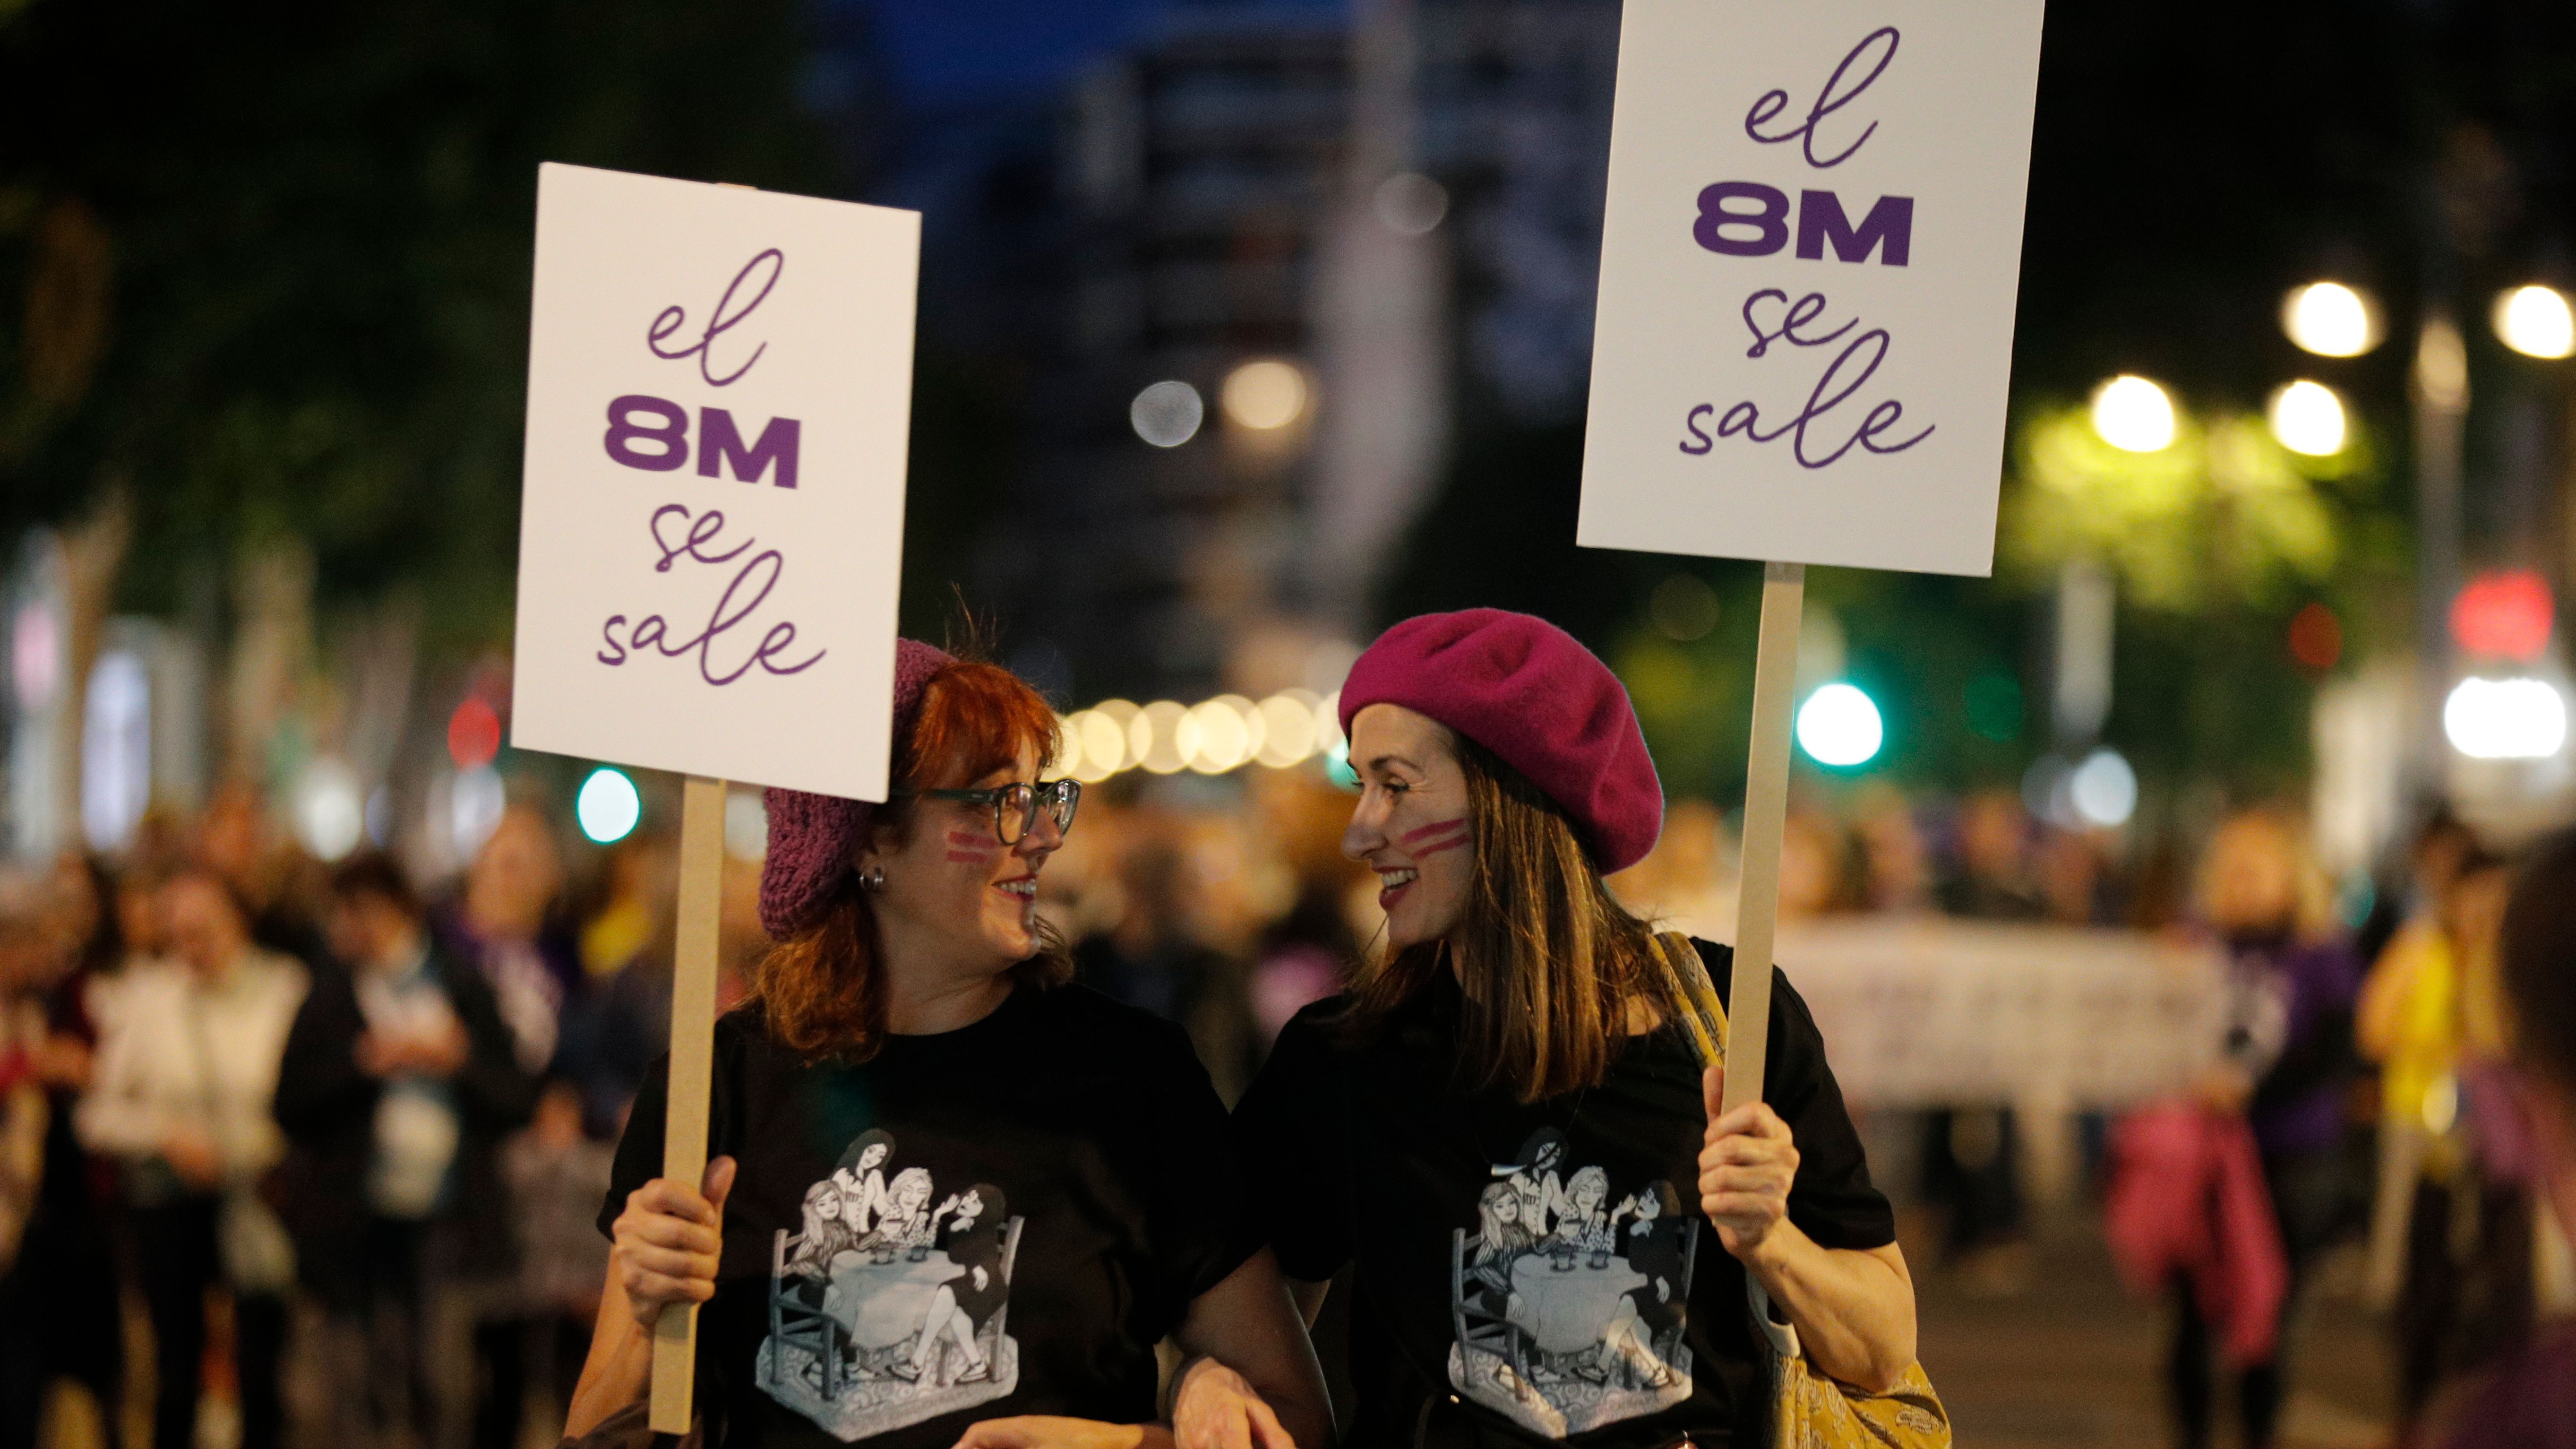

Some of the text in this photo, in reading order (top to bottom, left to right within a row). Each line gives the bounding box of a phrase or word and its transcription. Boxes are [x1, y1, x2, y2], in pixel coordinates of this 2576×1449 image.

[1744, 26, 1900, 169] el
[1692, 181, 1915, 267] 8M
[647, 248, 784, 388] el
[1742, 288, 1859, 359] se
[603, 394, 801, 490] 8M
[1679, 328, 1936, 470] sale
[650, 503, 755, 573] se
[597, 549, 826, 687] sale
